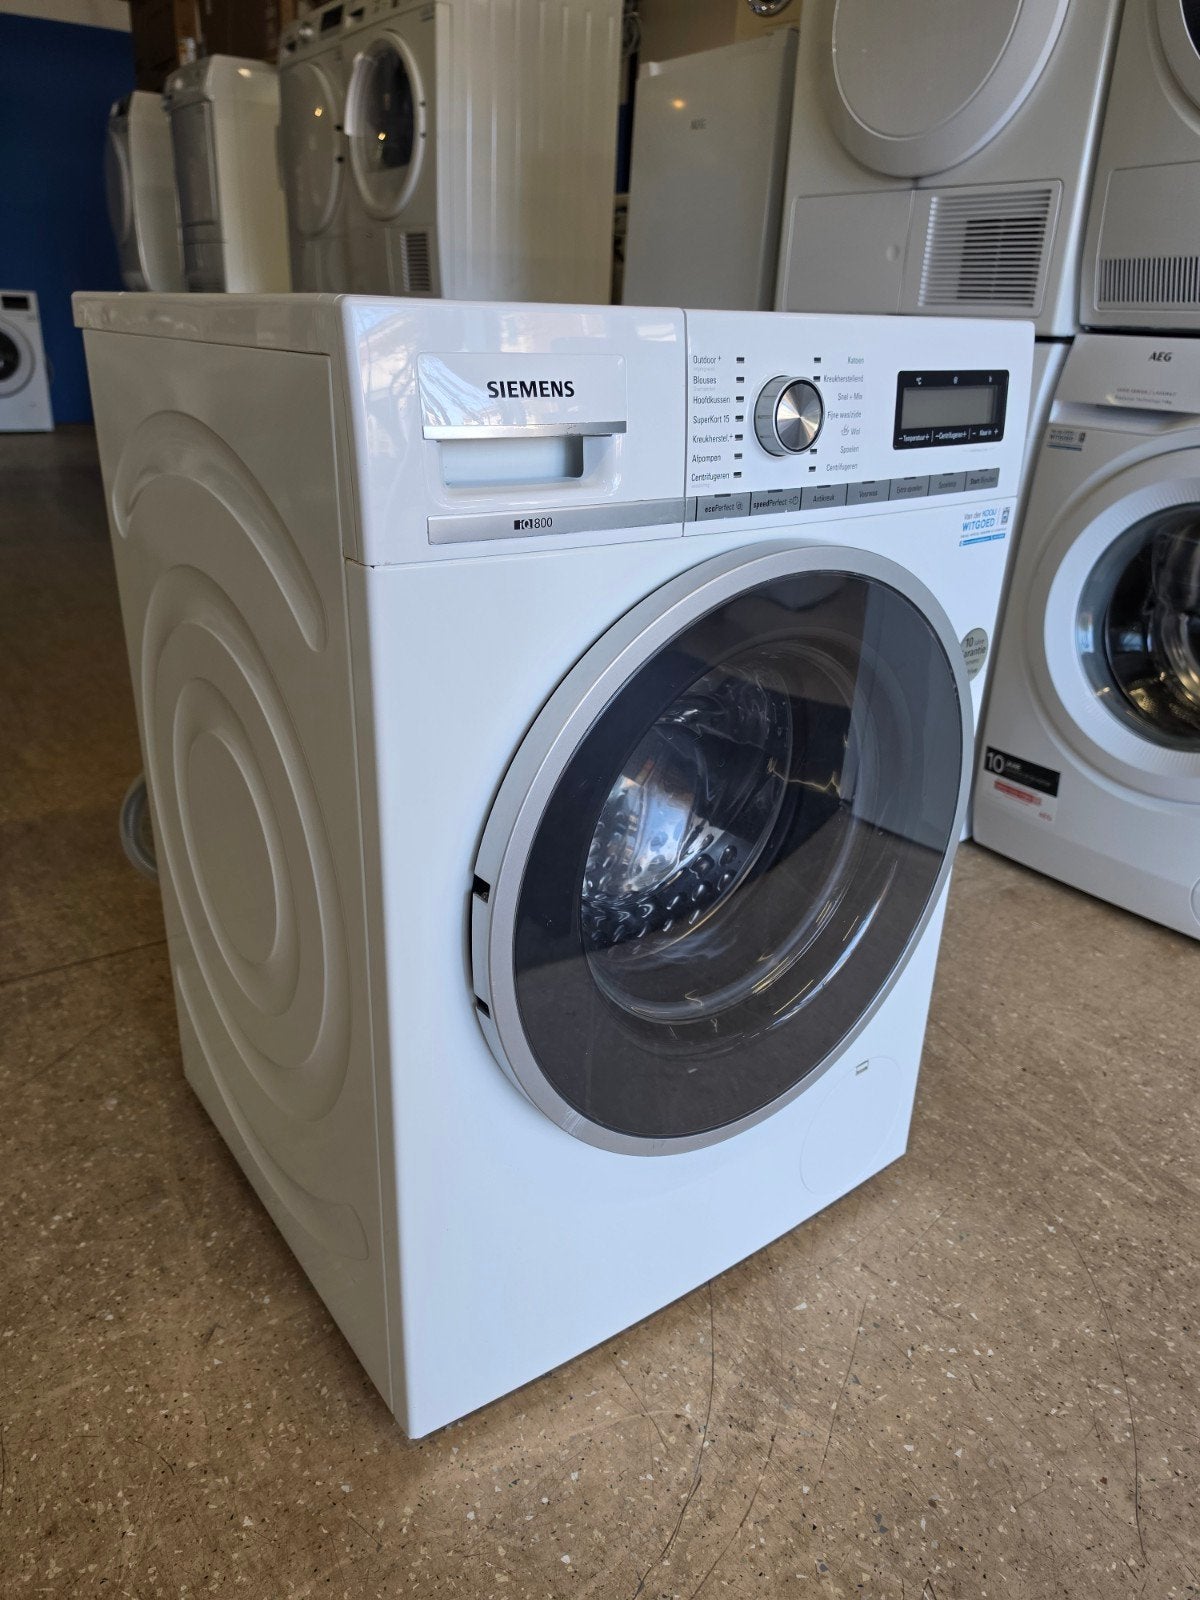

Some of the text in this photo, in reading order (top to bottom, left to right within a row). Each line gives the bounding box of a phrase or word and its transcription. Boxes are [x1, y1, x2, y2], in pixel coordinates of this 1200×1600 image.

[693, 355, 716, 364] Outdoor
[1149, 351, 1173, 362] AEG
[693, 375, 717, 385] Blouses
[487, 381, 575, 398] SIEMENS
[692, 395, 731, 405] Hoofdkussen
[692, 414, 730, 426] SuperKort 15
[691, 472, 730, 482] Centrifugeren
[704, 503, 735, 513] ecoPerfect
[753, 499, 787, 510] speedPerfect
[962, 517, 995, 531] WITGOED
[966, 636, 974, 647] 10
[987, 751, 1005, 774] 10
